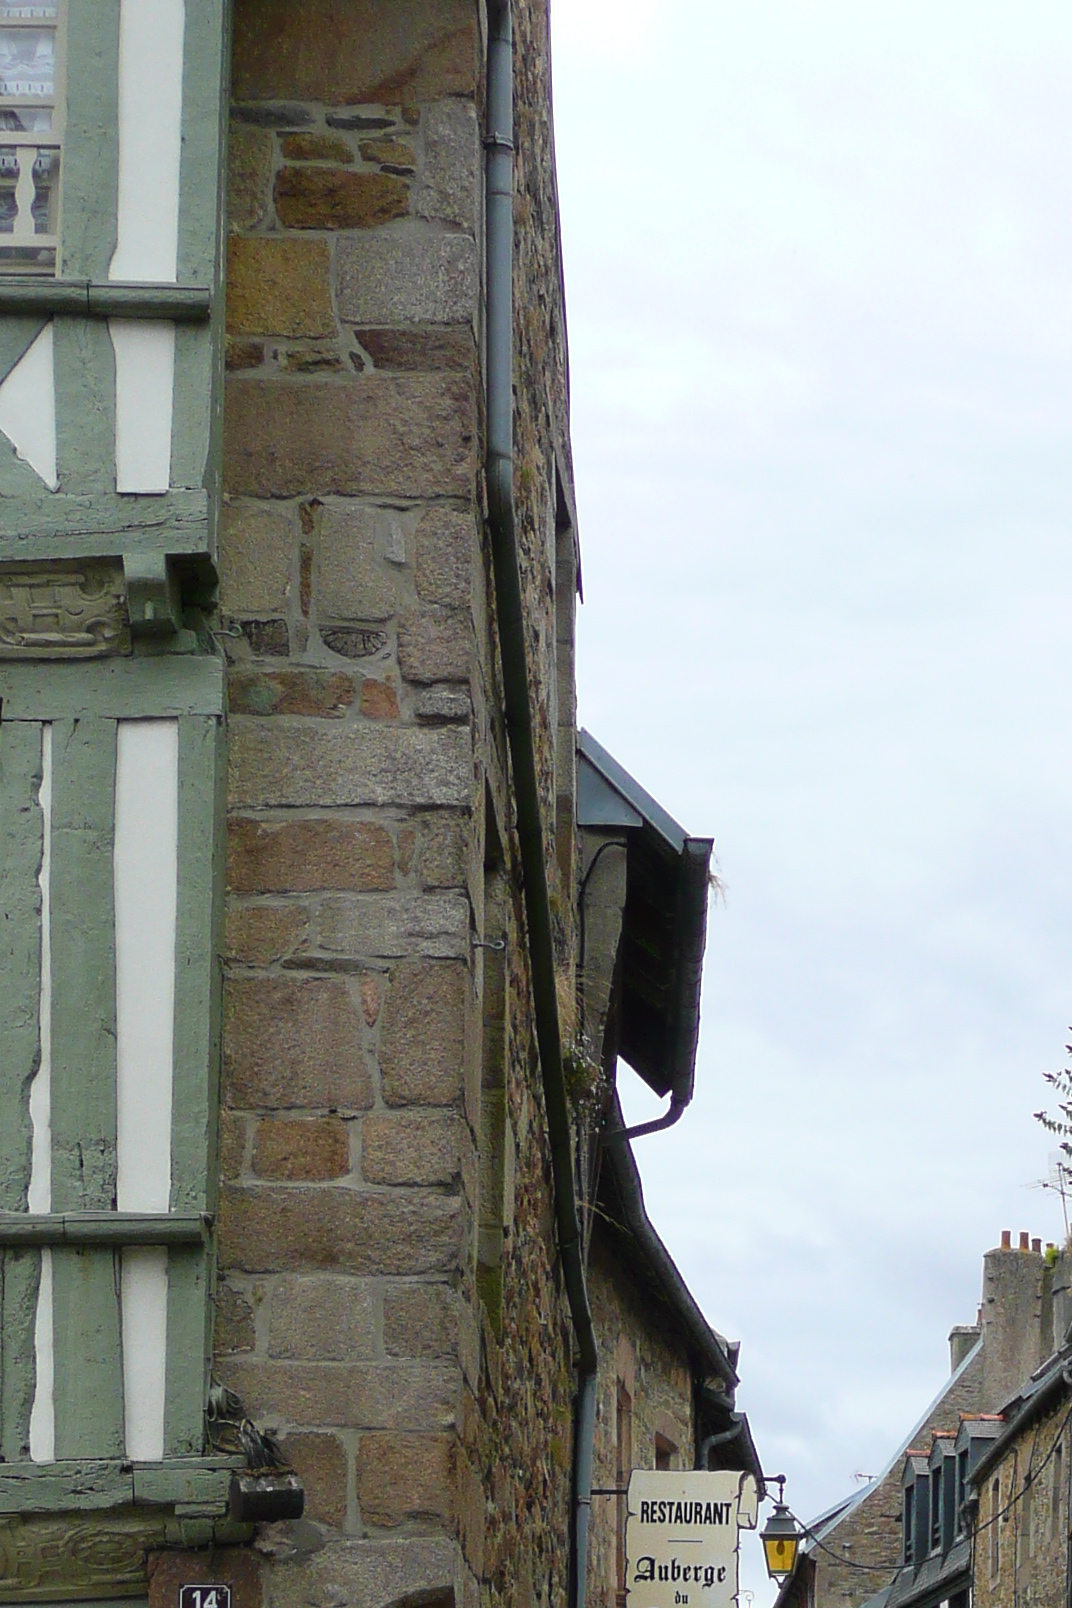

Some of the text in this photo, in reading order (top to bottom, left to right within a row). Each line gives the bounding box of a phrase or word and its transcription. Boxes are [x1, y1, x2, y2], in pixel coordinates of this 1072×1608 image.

[640, 1500, 732, 1526] RESTAURANT
[633, 1556, 726, 1588] Auberge
[674, 1590, 689, 1605] du
